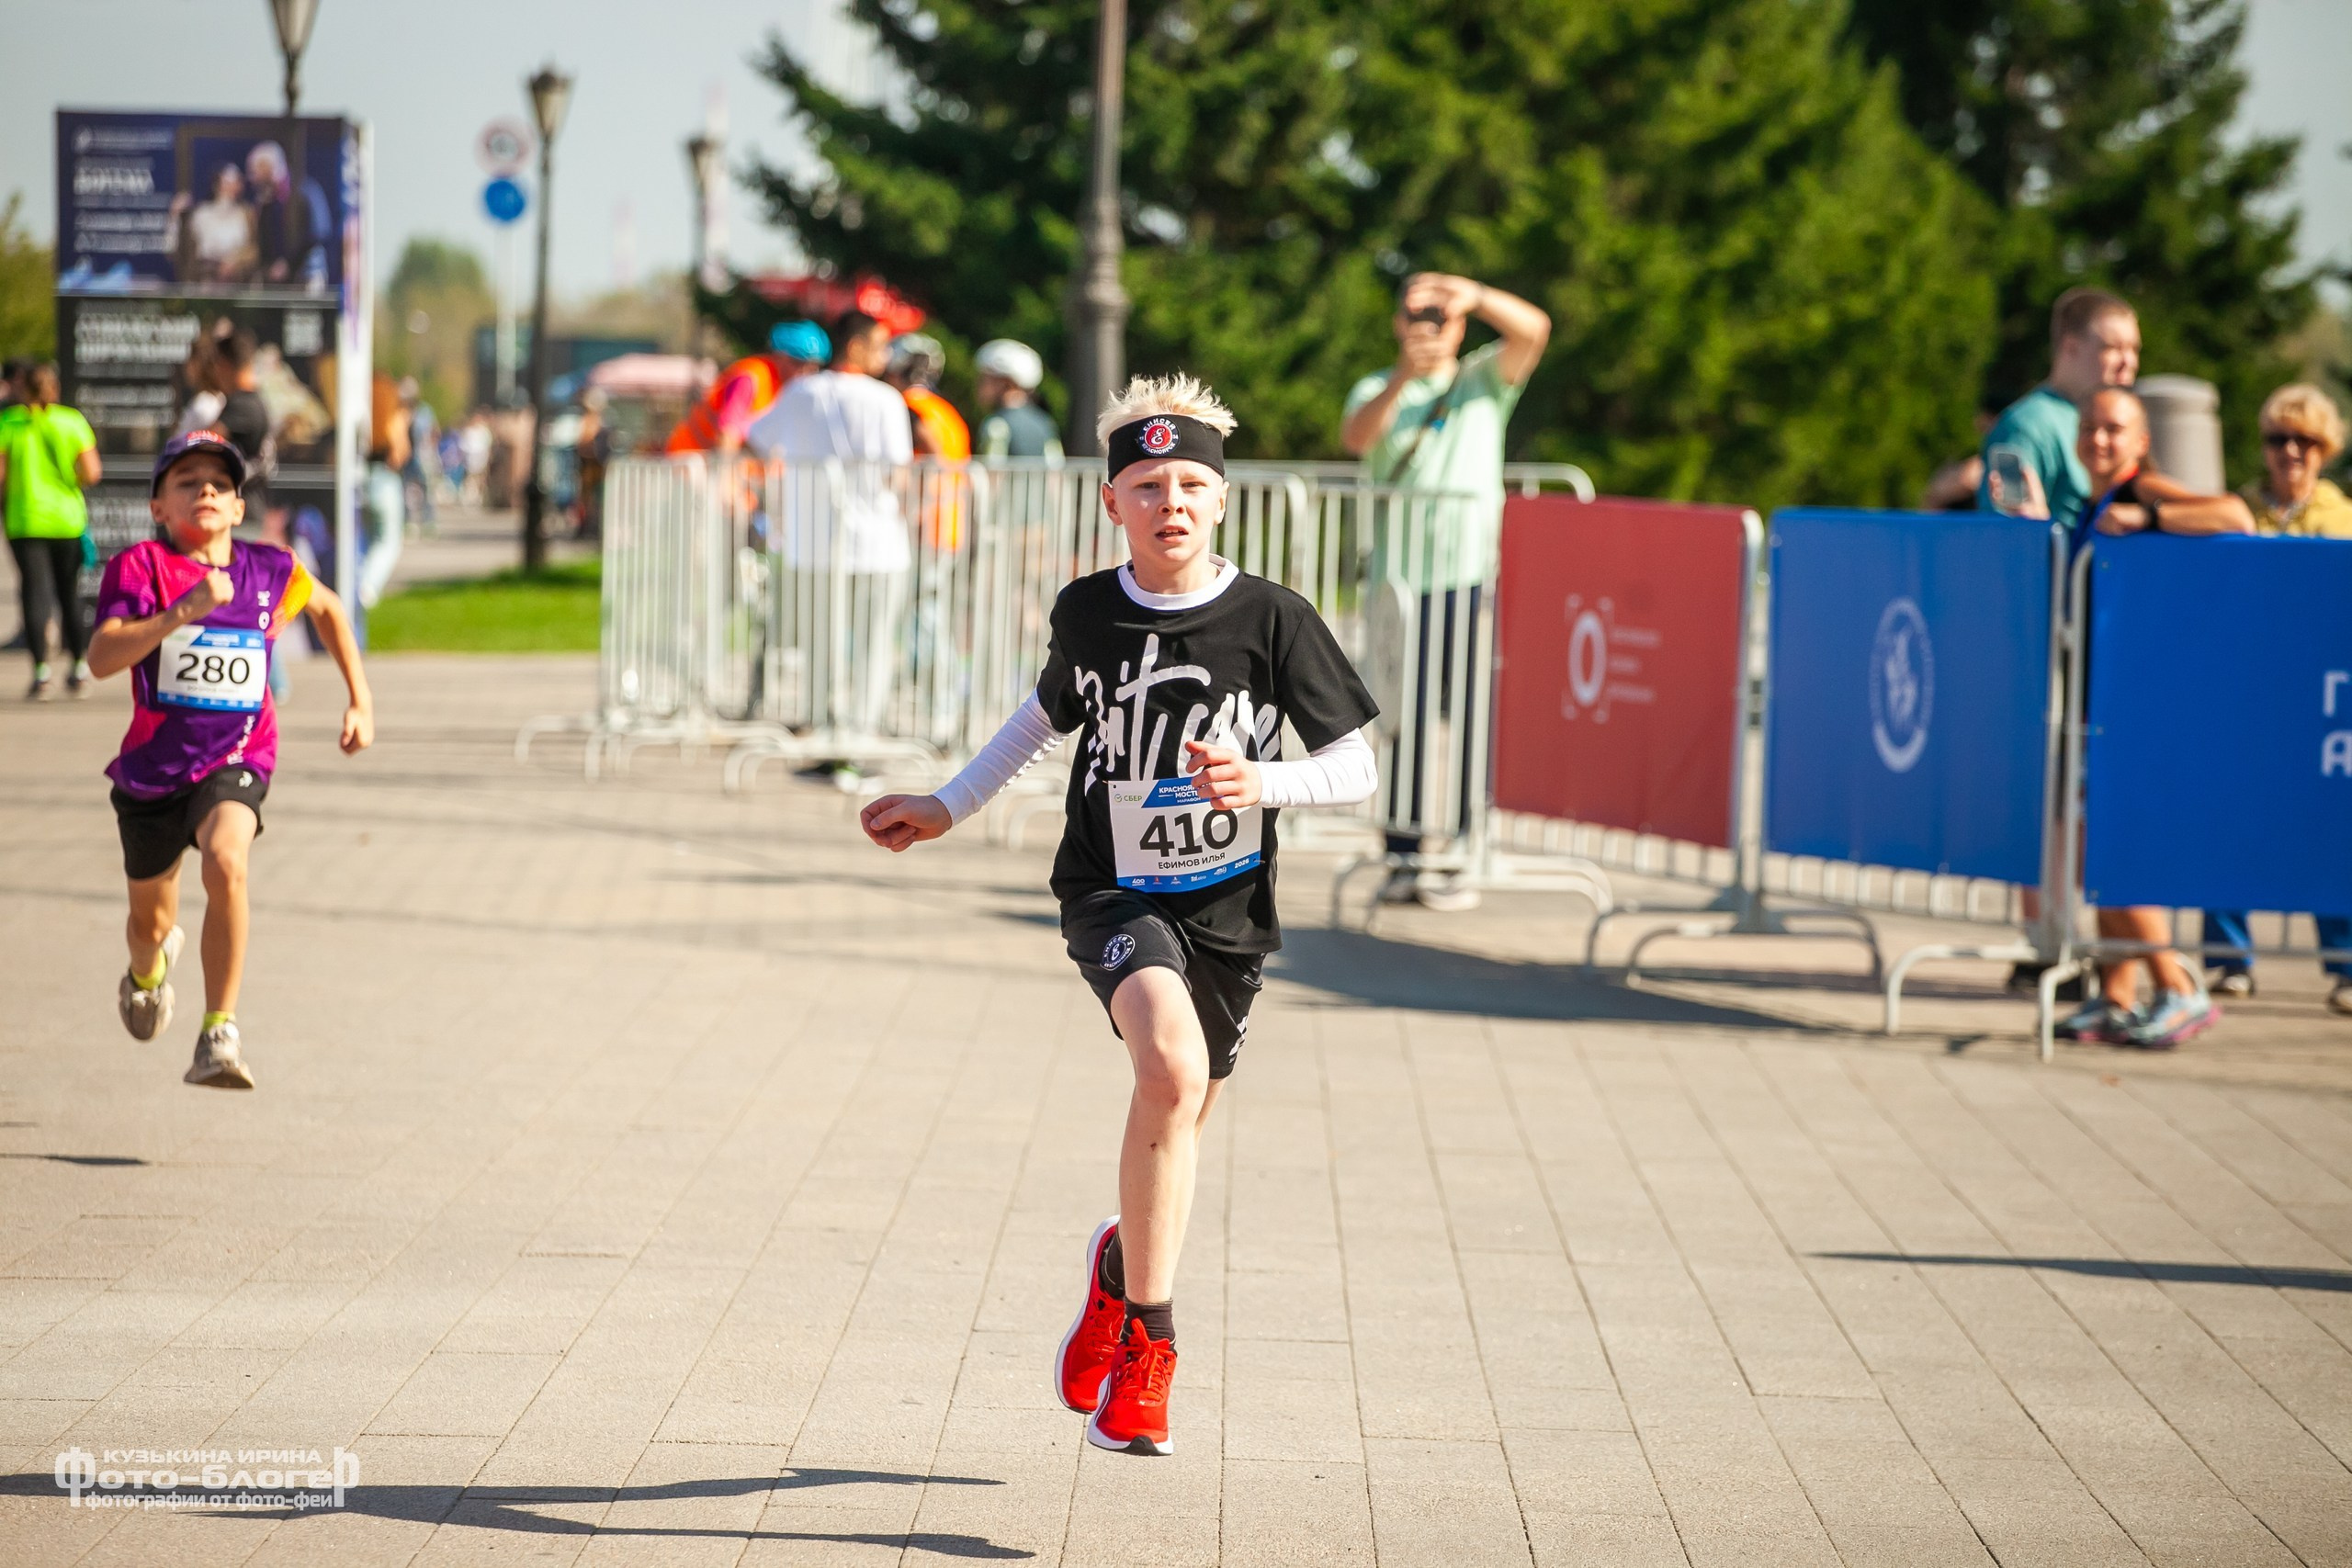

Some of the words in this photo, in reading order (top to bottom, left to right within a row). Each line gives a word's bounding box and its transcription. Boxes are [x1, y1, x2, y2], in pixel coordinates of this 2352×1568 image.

[175, 653, 250, 684] 280
[1159, 784, 1195, 794] КРАСНОЯ
[1139, 808, 1238, 857] 410
[1159, 858, 1200, 870] ЕФИМОВ
[1202, 852, 1226, 864] ИЛЬЯ
